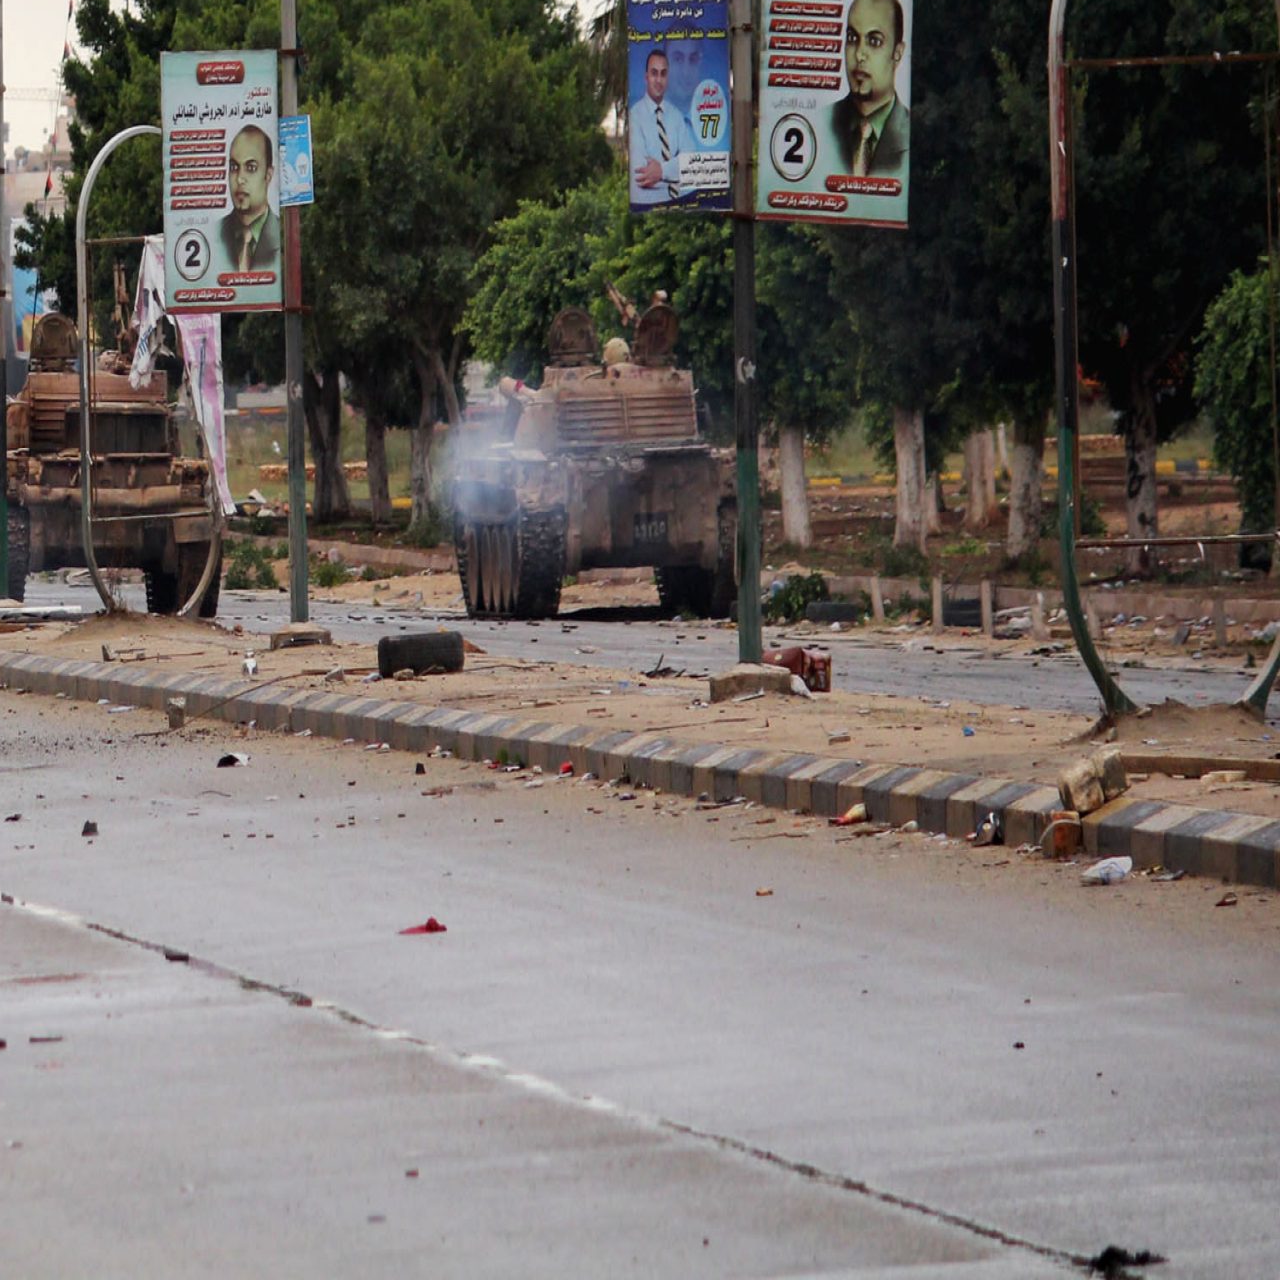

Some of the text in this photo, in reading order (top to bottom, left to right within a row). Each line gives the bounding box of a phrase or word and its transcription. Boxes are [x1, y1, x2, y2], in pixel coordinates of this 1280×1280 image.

[199, 102, 227, 124] الجروشي
[256, 100, 272, 117] طارق
[700, 114, 720, 139] 77
[783, 127, 804, 164] 2
[185, 240, 201, 267] 2
